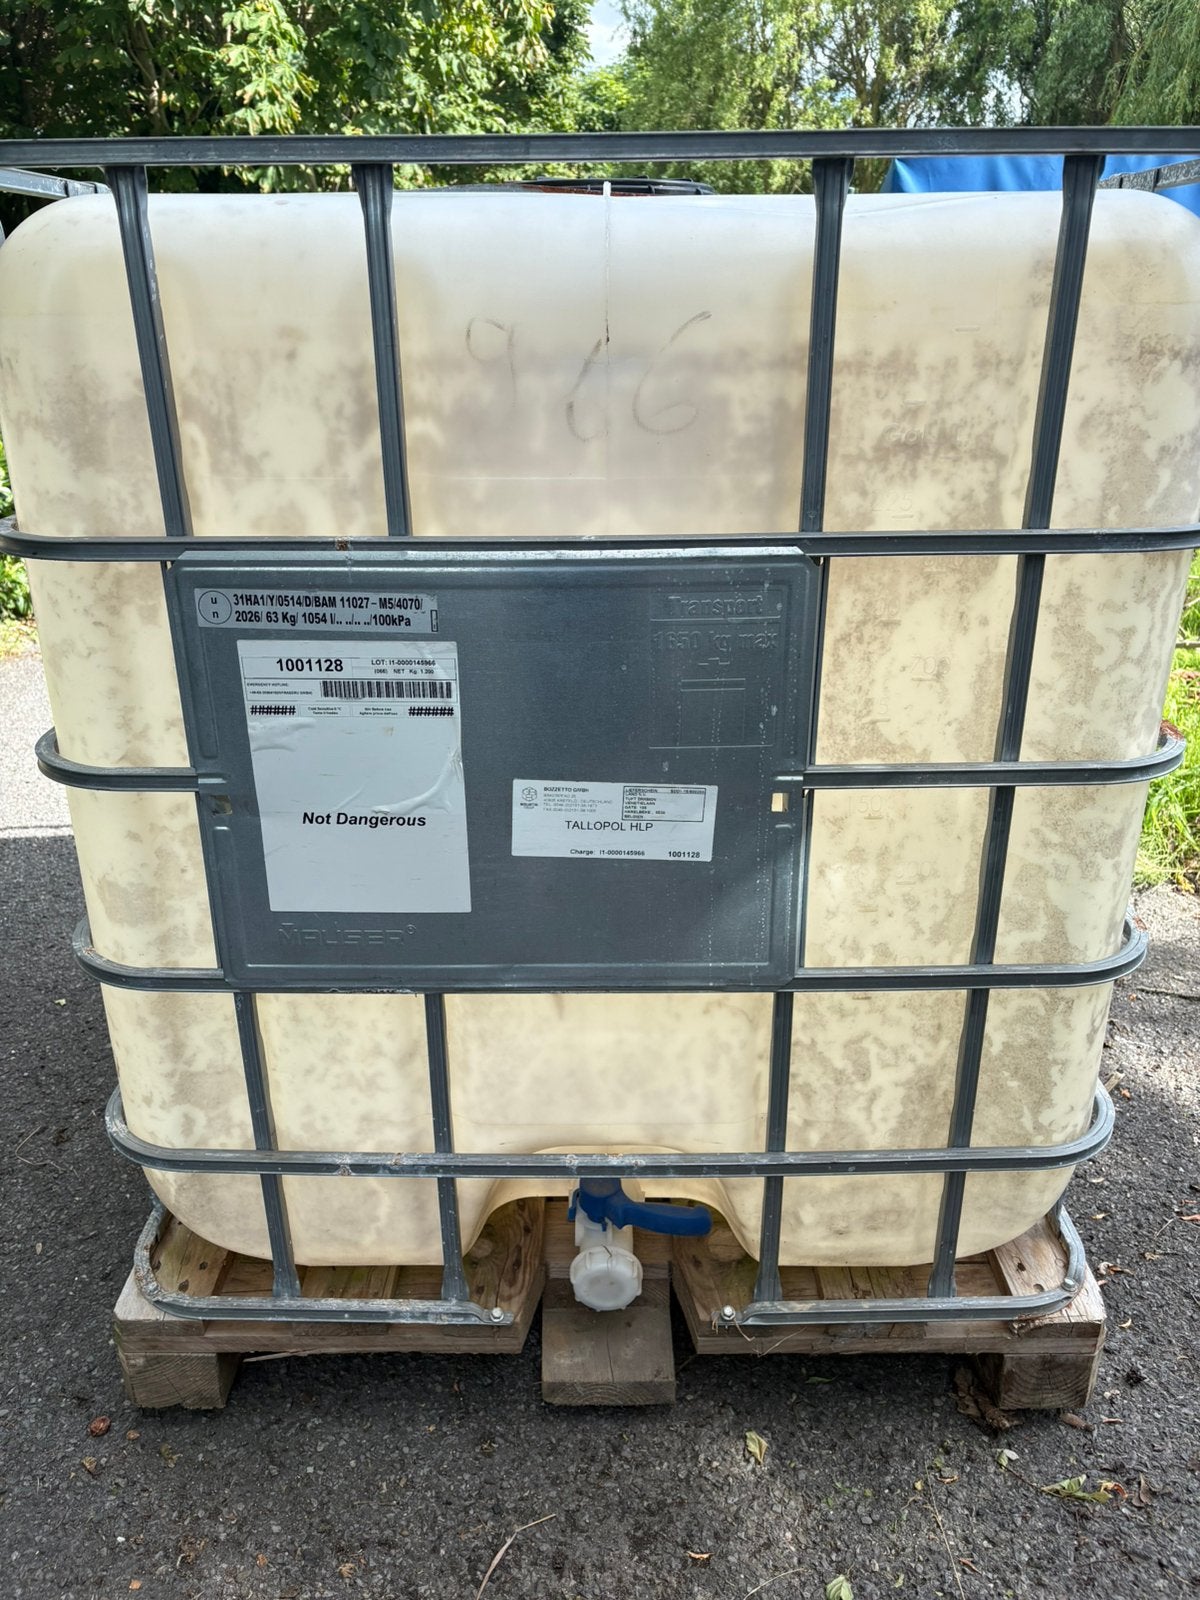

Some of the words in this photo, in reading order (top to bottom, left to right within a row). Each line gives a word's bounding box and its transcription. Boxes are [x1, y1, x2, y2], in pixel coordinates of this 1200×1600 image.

[340, 596, 370, 609] 11027
[265, 611, 279, 624] 63
[301, 612, 328, 625] 1054
[276, 657, 345, 673] 1001128
[371, 659, 388, 667] LOT:
[302, 811, 332, 825] Not
[336, 812, 427, 829] Dangerous
[565, 819, 627, 832] TALLOPOL
[630, 821, 654, 832] HLP
[668, 850, 701, 859] 1001128
